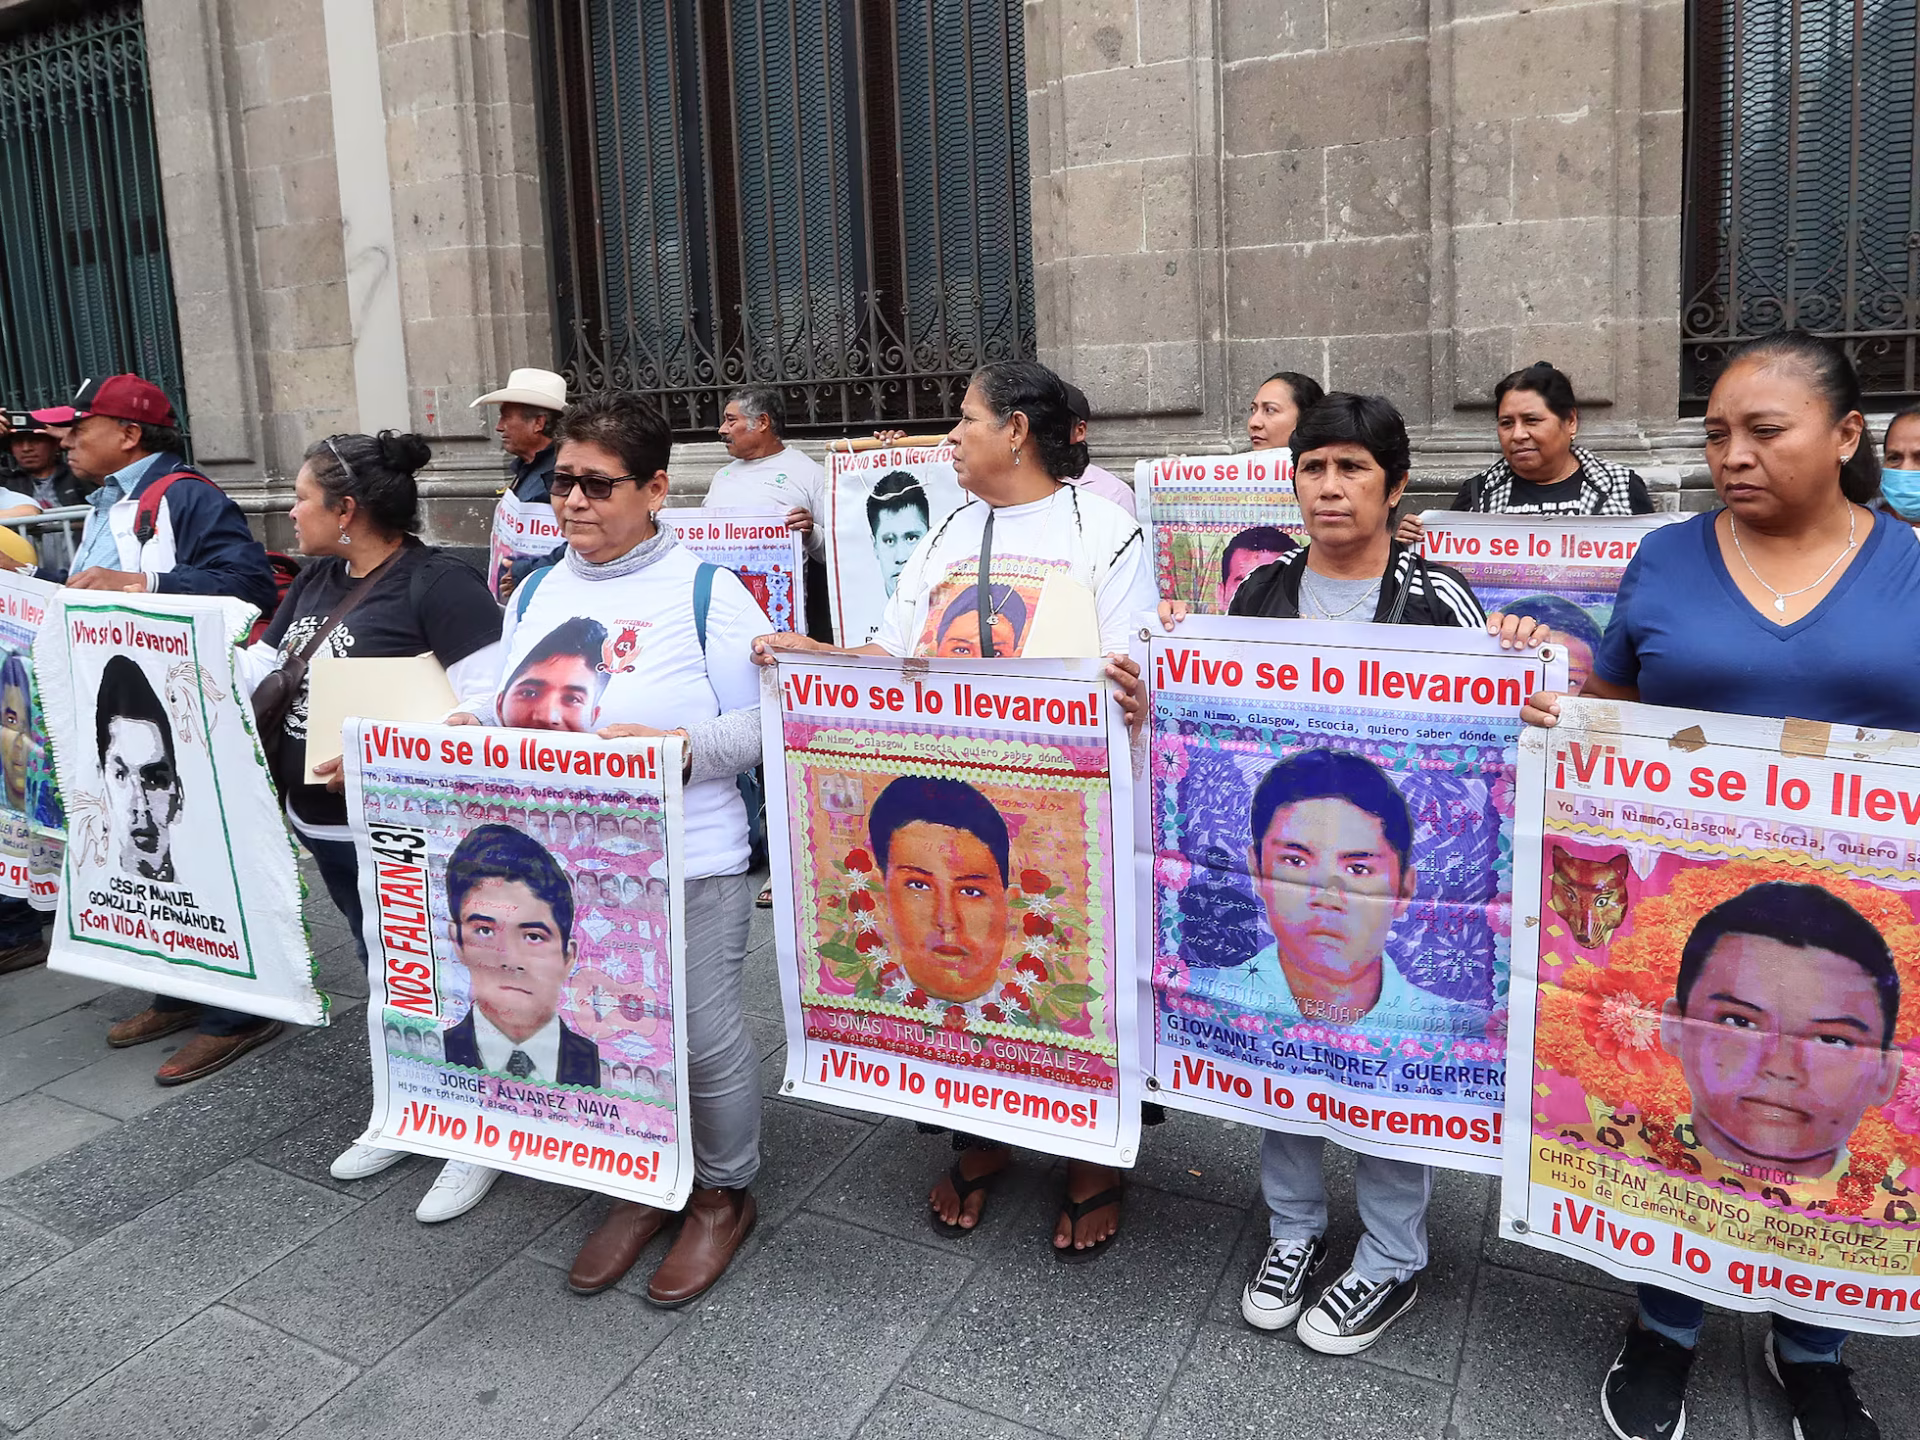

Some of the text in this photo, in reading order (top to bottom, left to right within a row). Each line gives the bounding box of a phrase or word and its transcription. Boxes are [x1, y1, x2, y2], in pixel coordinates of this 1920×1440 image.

[873, 453, 886, 468] se
[891, 450, 901, 466] lo
[1154, 460, 1206, 487] ¡Vivo
[1214, 465, 1239, 481] se
[1248, 460, 1266, 481] lo
[688, 522, 790, 540] se lo llevaron!
[1489, 537, 1519, 557] se
[1528, 533, 1551, 558] lo
[1561, 534, 1638, 560] llevar
[125, 621, 188, 657] llevaron!
[784, 674, 1099, 727] ¡Vivo se lo llevaron!
[1156, 648, 1536, 706] ¡Vivo se lo llevaron!
[827, 735, 859, 746] Nimmo,
[864, 738, 907, 751] Glasgow,
[914, 742, 956, 754] Escocia,
[964, 747, 998, 759] quiero
[1156, 705, 1519, 743] Yo, Jan Nimmo, Glasgow, Escocia, quiero saber dónde es
[364, 725, 656, 779] ¡Vivo se lo llevaron!
[531, 788, 563, 801] quiero
[568, 791, 598, 801] saber
[1555, 741, 1920, 827] ¡Vivo se lo llev
[368, 822, 426, 864] 43!
[1557, 800, 1579, 816] Yo,
[1590, 806, 1614, 820] Jan
[1754, 828, 1825, 851] Escocia,
[1838, 841, 1898, 860] quiero
[79, 908, 109, 932] ¡Con
[111, 913, 148, 940] VIDA
[163, 930, 239, 960] queremos!
[378, 861, 429, 956] FALTAN
[388, 958, 433, 1015] NOS
[828, 1012, 1090, 1073] JONÁS TRUJILLO GONZÁLEZ
[832, 1031, 841, 1040] de
[995, 1062, 1016, 1072] años
[1167, 1014, 1258, 1052] GIOVANNI
[1272, 1041, 1388, 1077] GALINDREZ
[1167, 1033, 1191, 1046] Hijo
[1196, 1041, 1208, 1050] de
[1241, 1054, 1285, 1071] Alfredo
[1291, 1065, 1298, 1075] y
[1340, 1075, 1374, 1090] Elena
[1395, 1083, 1409, 1093] 19
[1415, 1084, 1443, 1096] años
[1464, 1088, 1505, 1102] Arceli
[398, 1081, 418, 1093] Hijo
[422, 1085, 432, 1095] de
[436, 1088, 475, 1104] Epifanio
[488, 1100, 518, 1113] Blanca
[533, 1109, 543, 1118] 19
[584, 1118, 605, 1130] Juan
[440, 1073, 487, 1094] JORGE
[577, 1099, 620, 1120] NAVA
[820, 1048, 1098, 1130] ¡Vivo lo queremos!
[1173, 1054, 1503, 1145] ¡Vivo lo queremos!
[397, 1101, 660, 1183] ¡Vivo lo queremos!
[1539, 1148, 1647, 1192] CHRISTIAN
[1658, 1182, 1750, 1223] ALFONSO
[1764, 1215, 1888, 1251] RODRÍGUEZ
[1551, 1170, 1586, 1190] Hijo
[1595, 1185, 1612, 1200] de
[1622, 1194, 1697, 1225] Clemente
[1706, 1221, 1716, 1233] y
[1727, 1226, 1756, 1243] Luz
[1839, 1250, 1907, 1271] Tixtla,
[1551, 1197, 1656, 1257] ¡Vivo
[1671, 1231, 1712, 1275] lo
